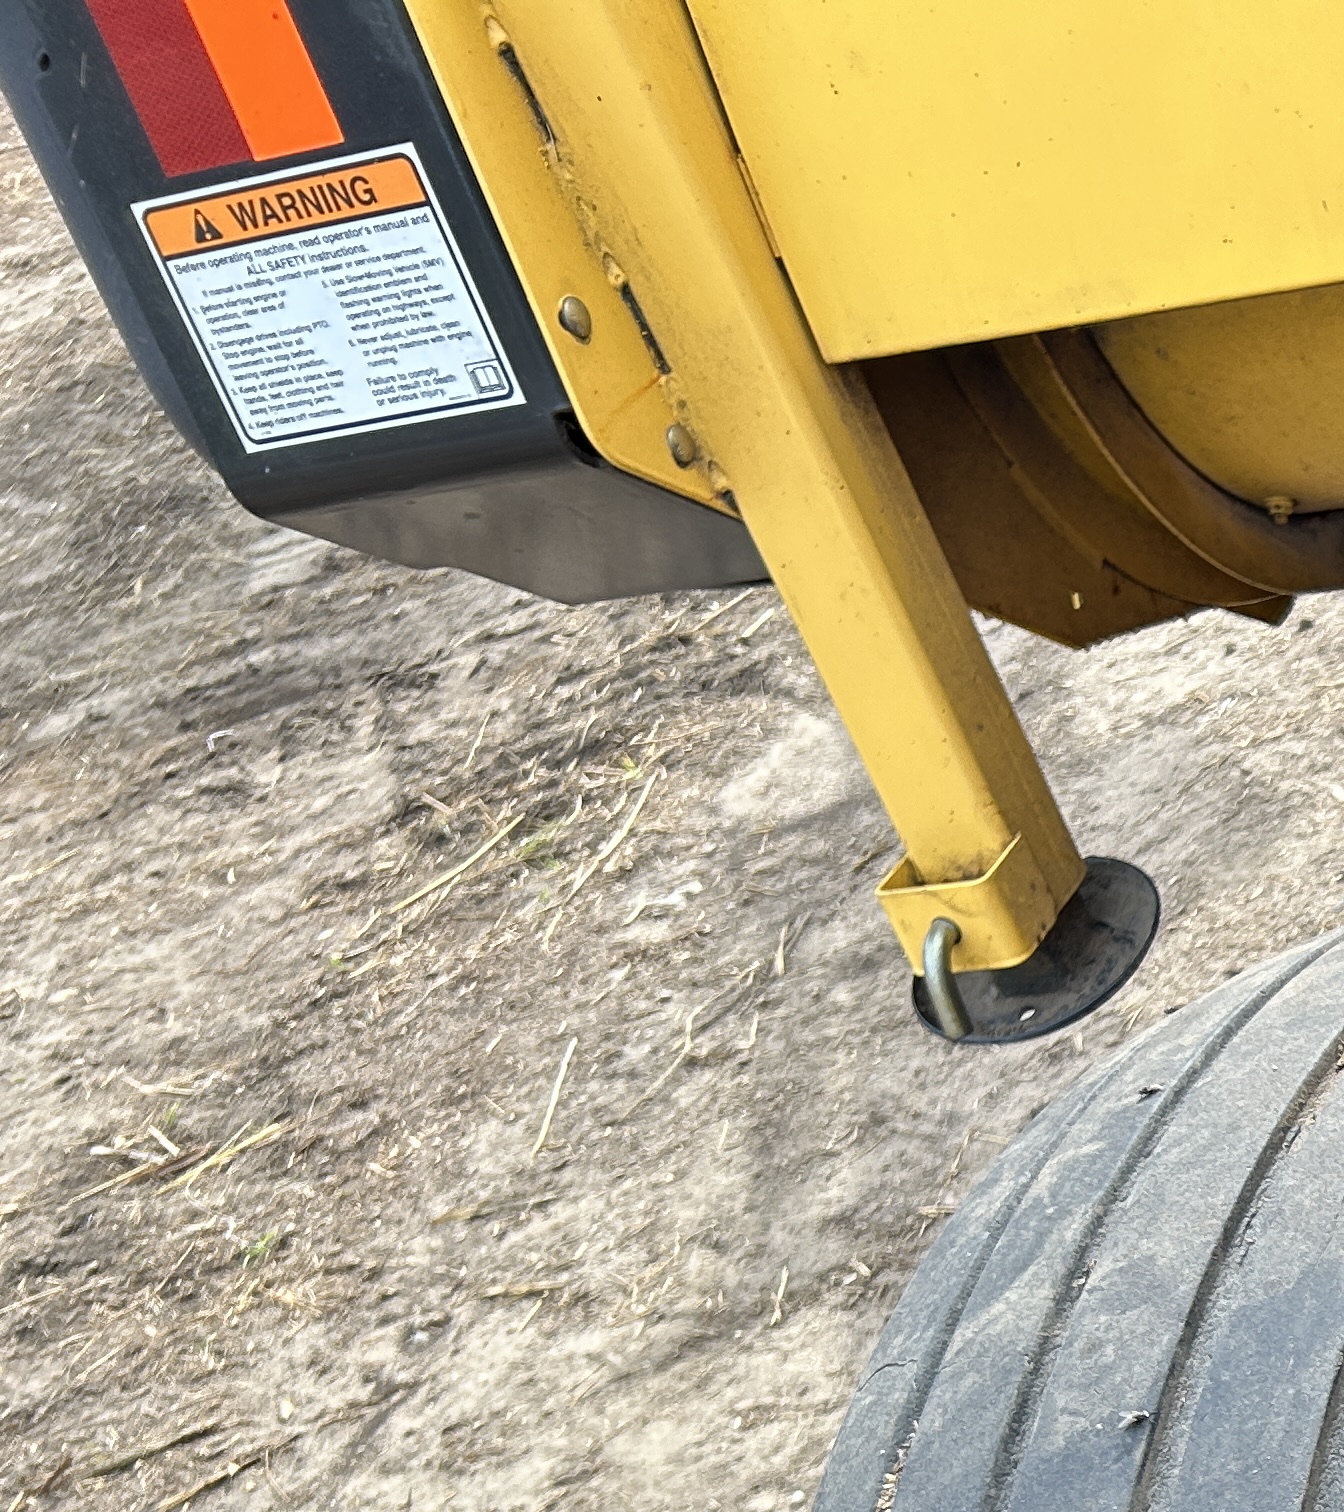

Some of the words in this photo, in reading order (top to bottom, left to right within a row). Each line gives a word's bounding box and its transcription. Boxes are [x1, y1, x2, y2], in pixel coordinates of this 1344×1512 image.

[226, 176, 378, 231] WARNING
[174, 262, 206, 275] Before
[208, 252, 253, 268] operating
[299, 235, 321, 248] read
[322, 226, 372, 244] operator's
[373, 217, 409, 232] manual
[410, 213, 430, 225] and
[247, 264, 267, 276] ALL
[267, 254, 306, 271] SAFETY
[308, 244, 369, 263] instructions.
[354, 256, 381, 266] service
[366, 376, 397, 386] Failure
[408, 367, 439, 379] comply
[372, 385, 396, 396] could
[397, 381, 421, 391] result
[433, 374, 456, 385] death
[387, 393, 419, 404] serious
